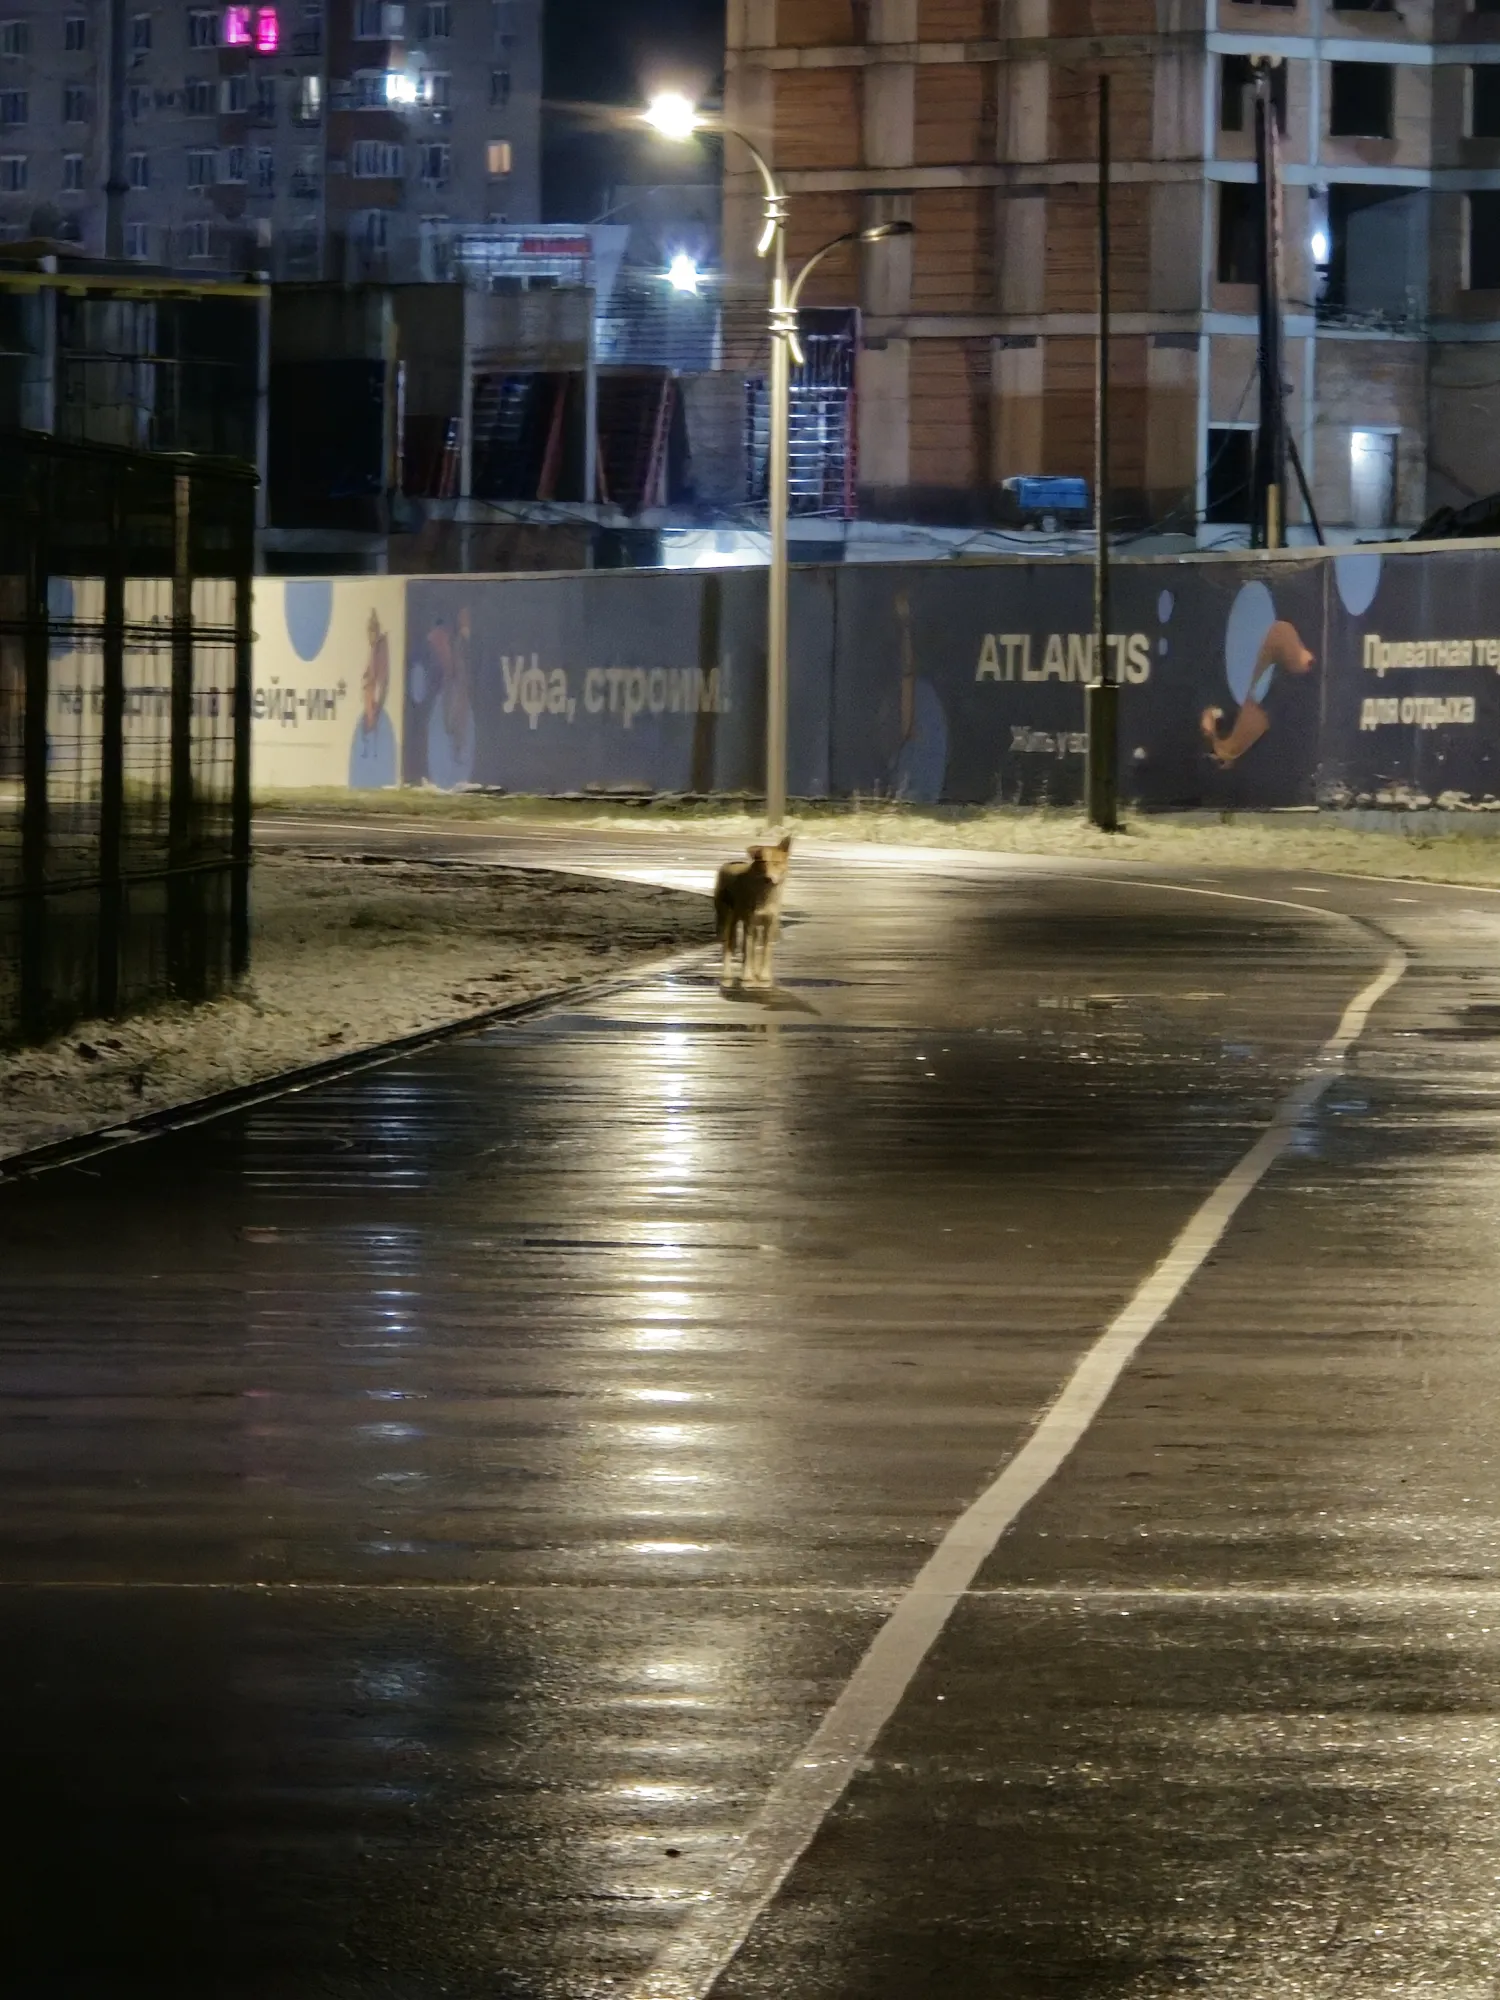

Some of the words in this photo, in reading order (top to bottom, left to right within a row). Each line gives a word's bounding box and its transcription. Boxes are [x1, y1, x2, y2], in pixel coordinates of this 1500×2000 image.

[1363, 633, 1473, 678] Приватная
[1475, 638, 1500, 677] те
[500, 652, 577, 731] Уфа,
[583, 652, 734, 730] строим!
[1358, 697, 1398, 732] для
[1400, 696, 1476, 731] отдыха
